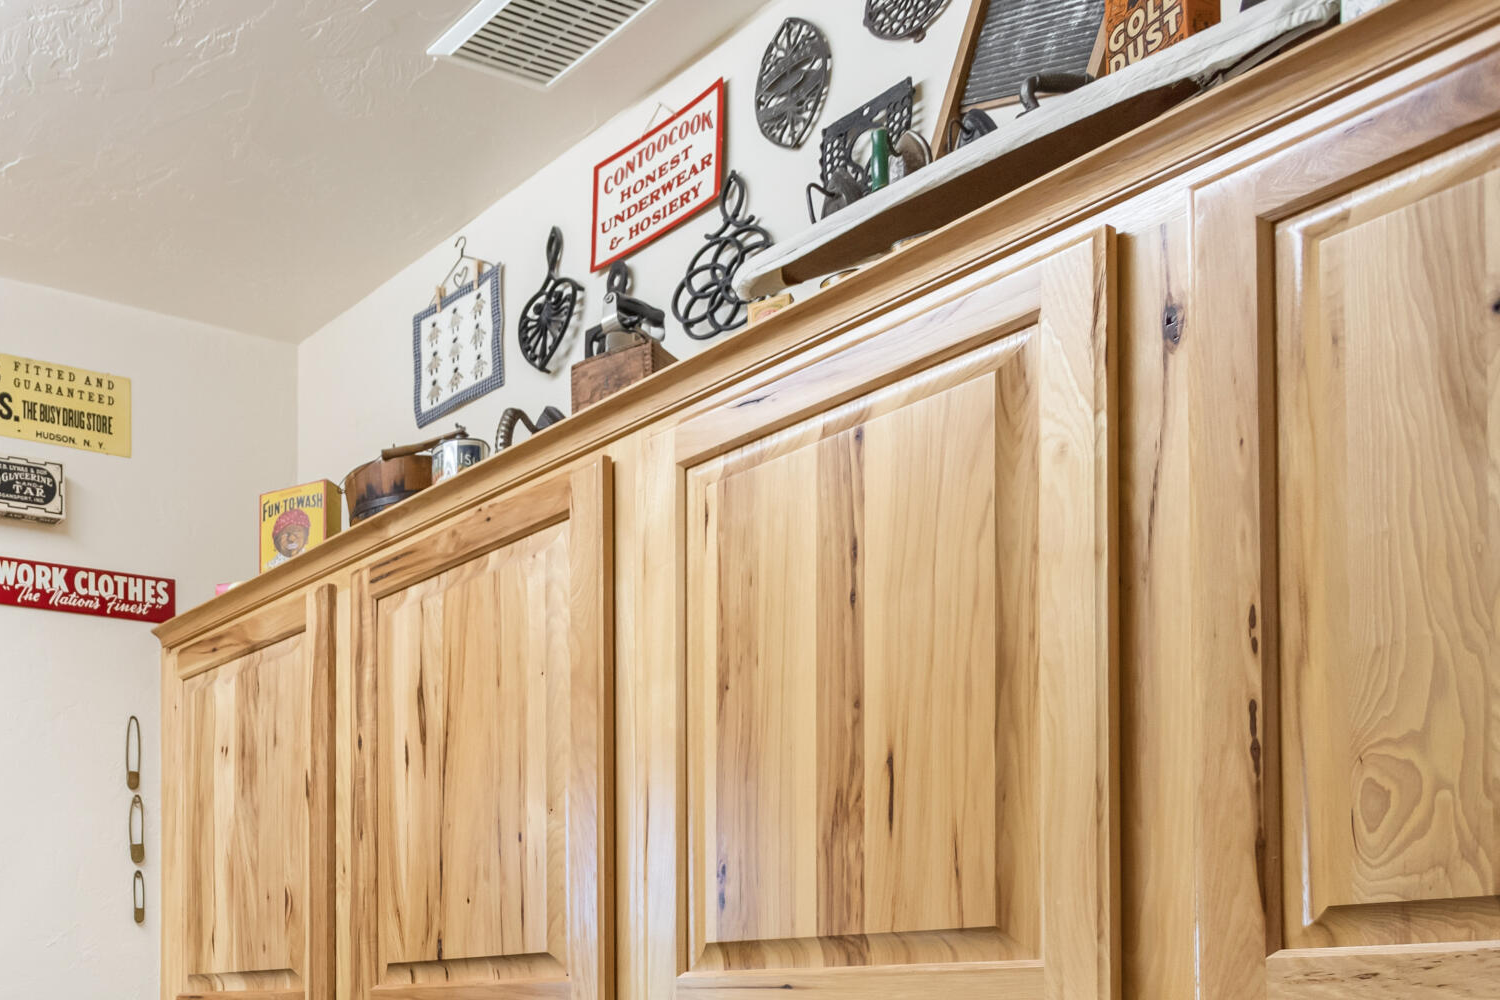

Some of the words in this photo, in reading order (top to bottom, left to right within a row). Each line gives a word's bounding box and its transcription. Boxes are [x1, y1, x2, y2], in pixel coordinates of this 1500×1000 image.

[1110, 5, 1182, 72] DUST
[604, 110, 713, 195] CONTOOCOOK
[620, 145, 693, 204] HONEST
[601, 153, 713, 234] UNDERWEAR
[609, 236, 624, 251] &
[628, 181, 703, 241] HOSIERY
[14, 361, 76, 382] FITTED
[84, 376, 115, 391] AND
[14, 378, 115, 406] GUARANTEED
[21, 400, 37, 420] THE
[39, 404, 62, 426] BUSY
[62, 409, 85, 430] DRUG
[86, 412, 113, 435] STORE
[1, 471, 53, 487] GLYCERINE
[12, 484, 46, 498] TAR
[74, 570, 169, 605] CLOTHES
